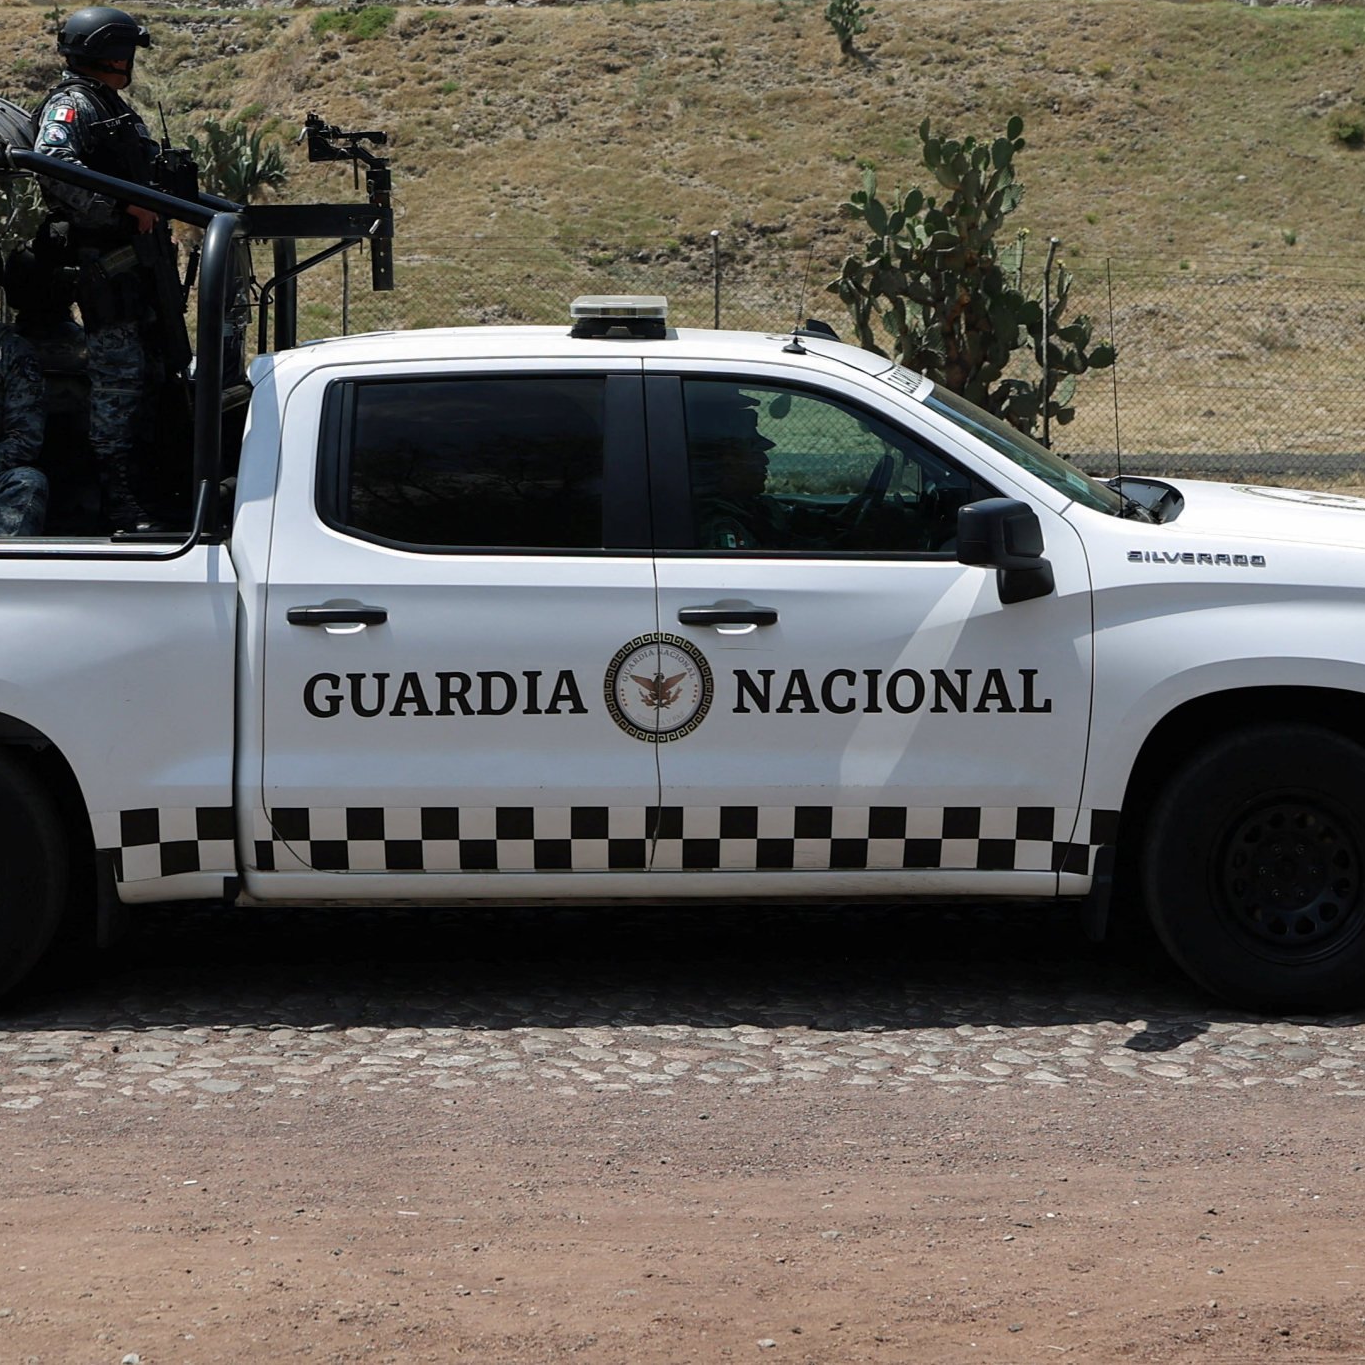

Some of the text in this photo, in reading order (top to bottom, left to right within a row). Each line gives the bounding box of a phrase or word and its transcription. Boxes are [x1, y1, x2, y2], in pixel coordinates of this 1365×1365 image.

[1127, 550, 1267, 567] SILVERADO
[303, 668, 1052, 718] GUARDIA NACIONAL
